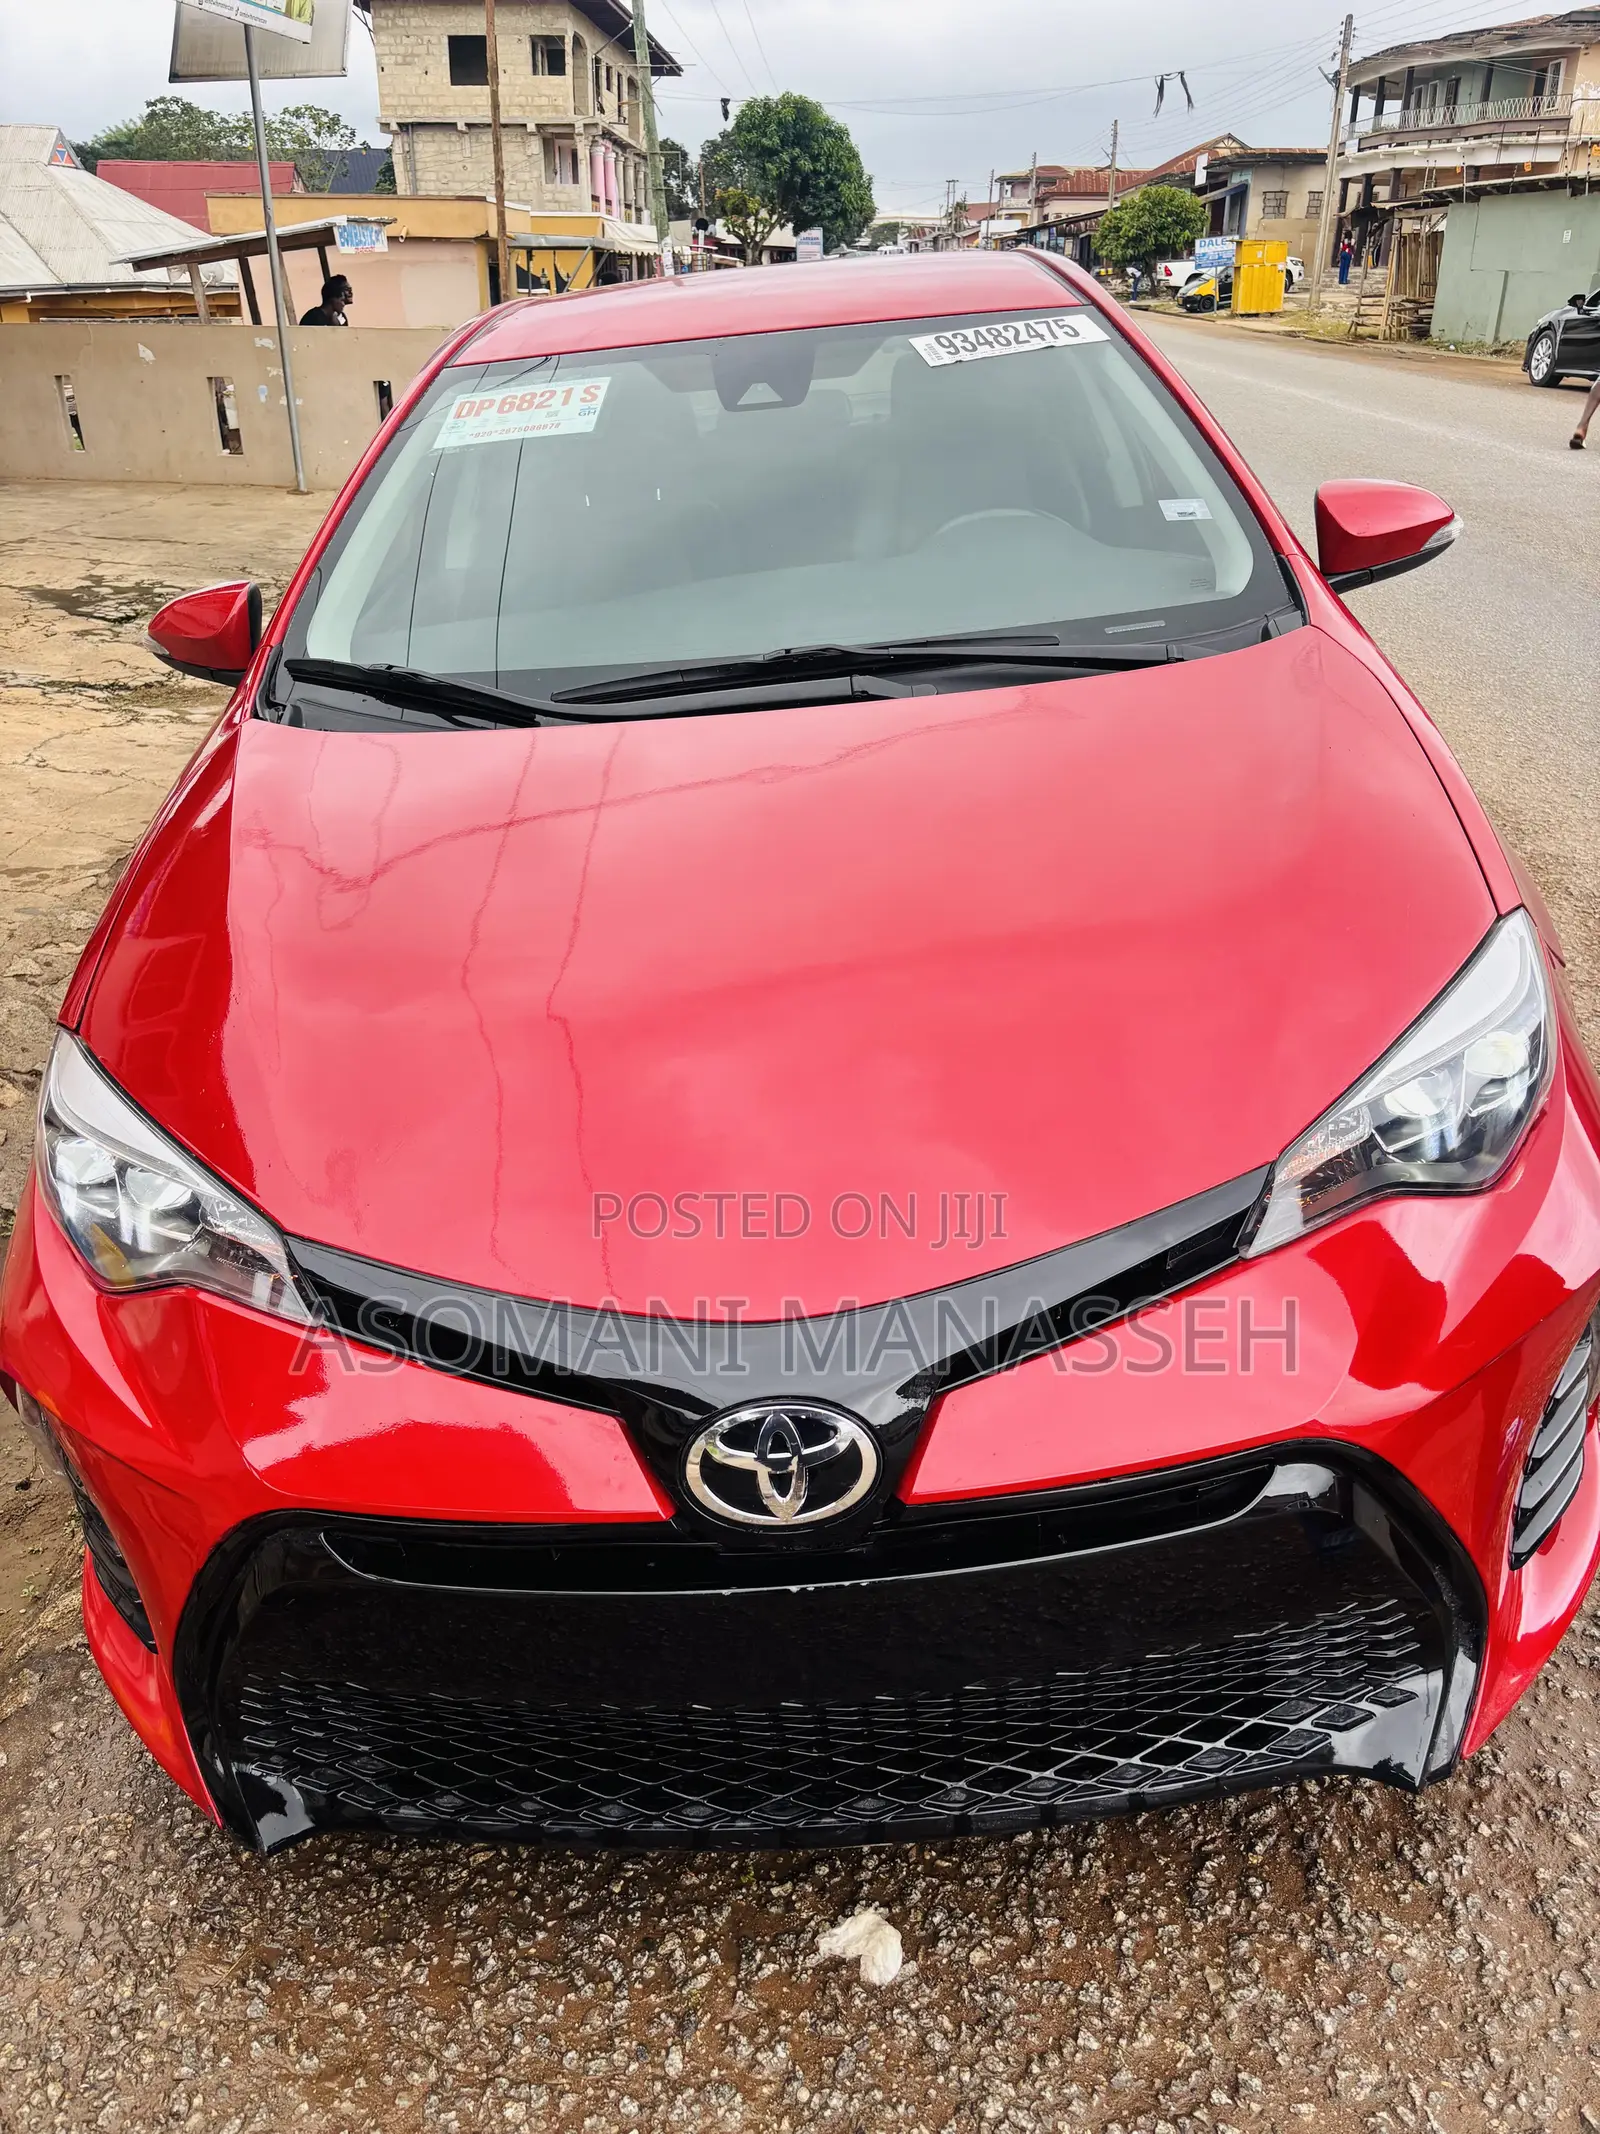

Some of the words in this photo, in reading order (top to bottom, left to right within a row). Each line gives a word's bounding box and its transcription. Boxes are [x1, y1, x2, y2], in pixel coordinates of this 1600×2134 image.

[934, 318, 1080, 355] 93482475
[453, 398, 496, 420] DP
[497, 387, 574, 414] 6821
[580, 385, 602, 403] S
